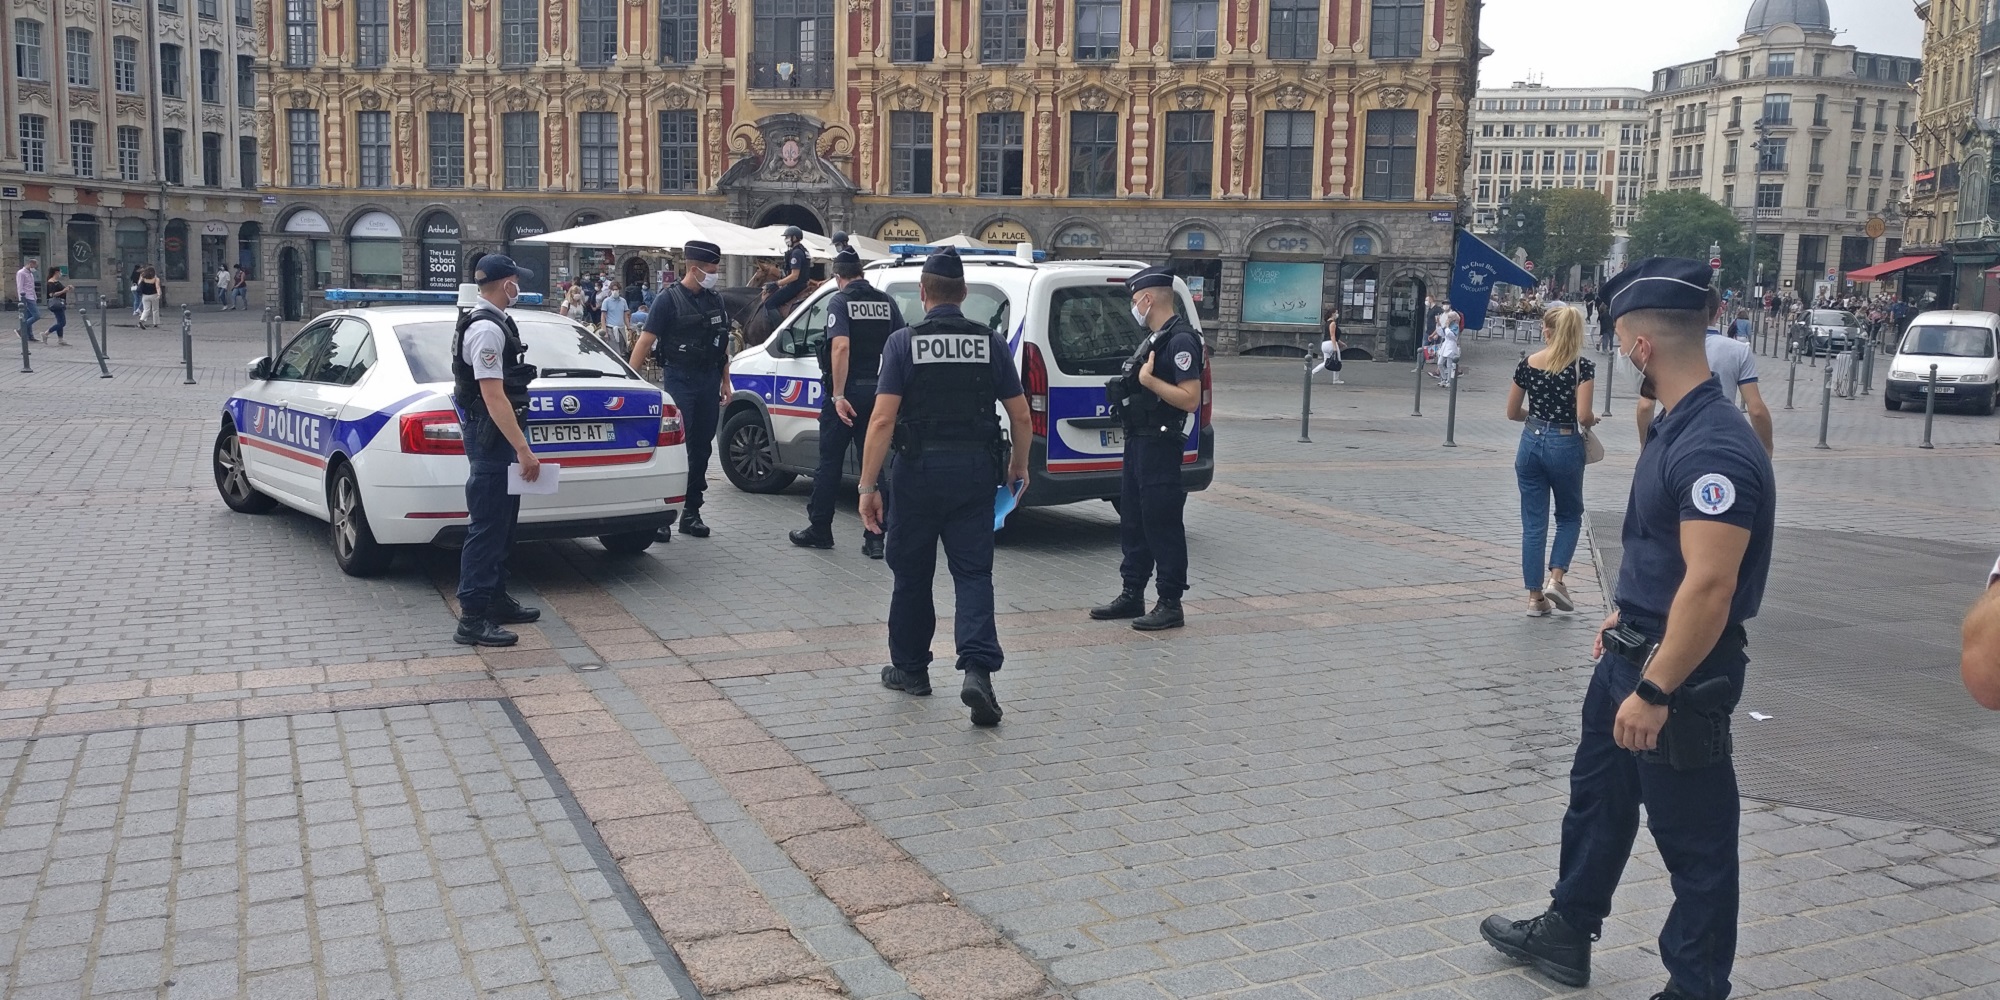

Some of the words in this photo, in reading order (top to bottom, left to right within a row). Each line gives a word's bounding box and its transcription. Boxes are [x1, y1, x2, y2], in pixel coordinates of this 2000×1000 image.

[428, 224, 446, 233] Arthur
[883, 228, 894, 236] LA
[896, 229, 920, 237] PLACE
[987, 231, 997, 239] LA
[1001, 232, 1026, 240] PLACE
[429, 249, 442, 258] They
[429, 256, 439, 264] be
[439, 256, 456, 264] back
[429, 263, 456, 273] soon
[1461, 264, 1470, 272] Au
[1485, 263, 1498, 275] Bleu
[851, 303, 889, 317] POLICE
[916, 338, 985, 359] POLICE
[268, 408, 320, 450] POLICE
[530, 424, 603, 442] EV-679-AT
[607, 432, 616, 441] 59
